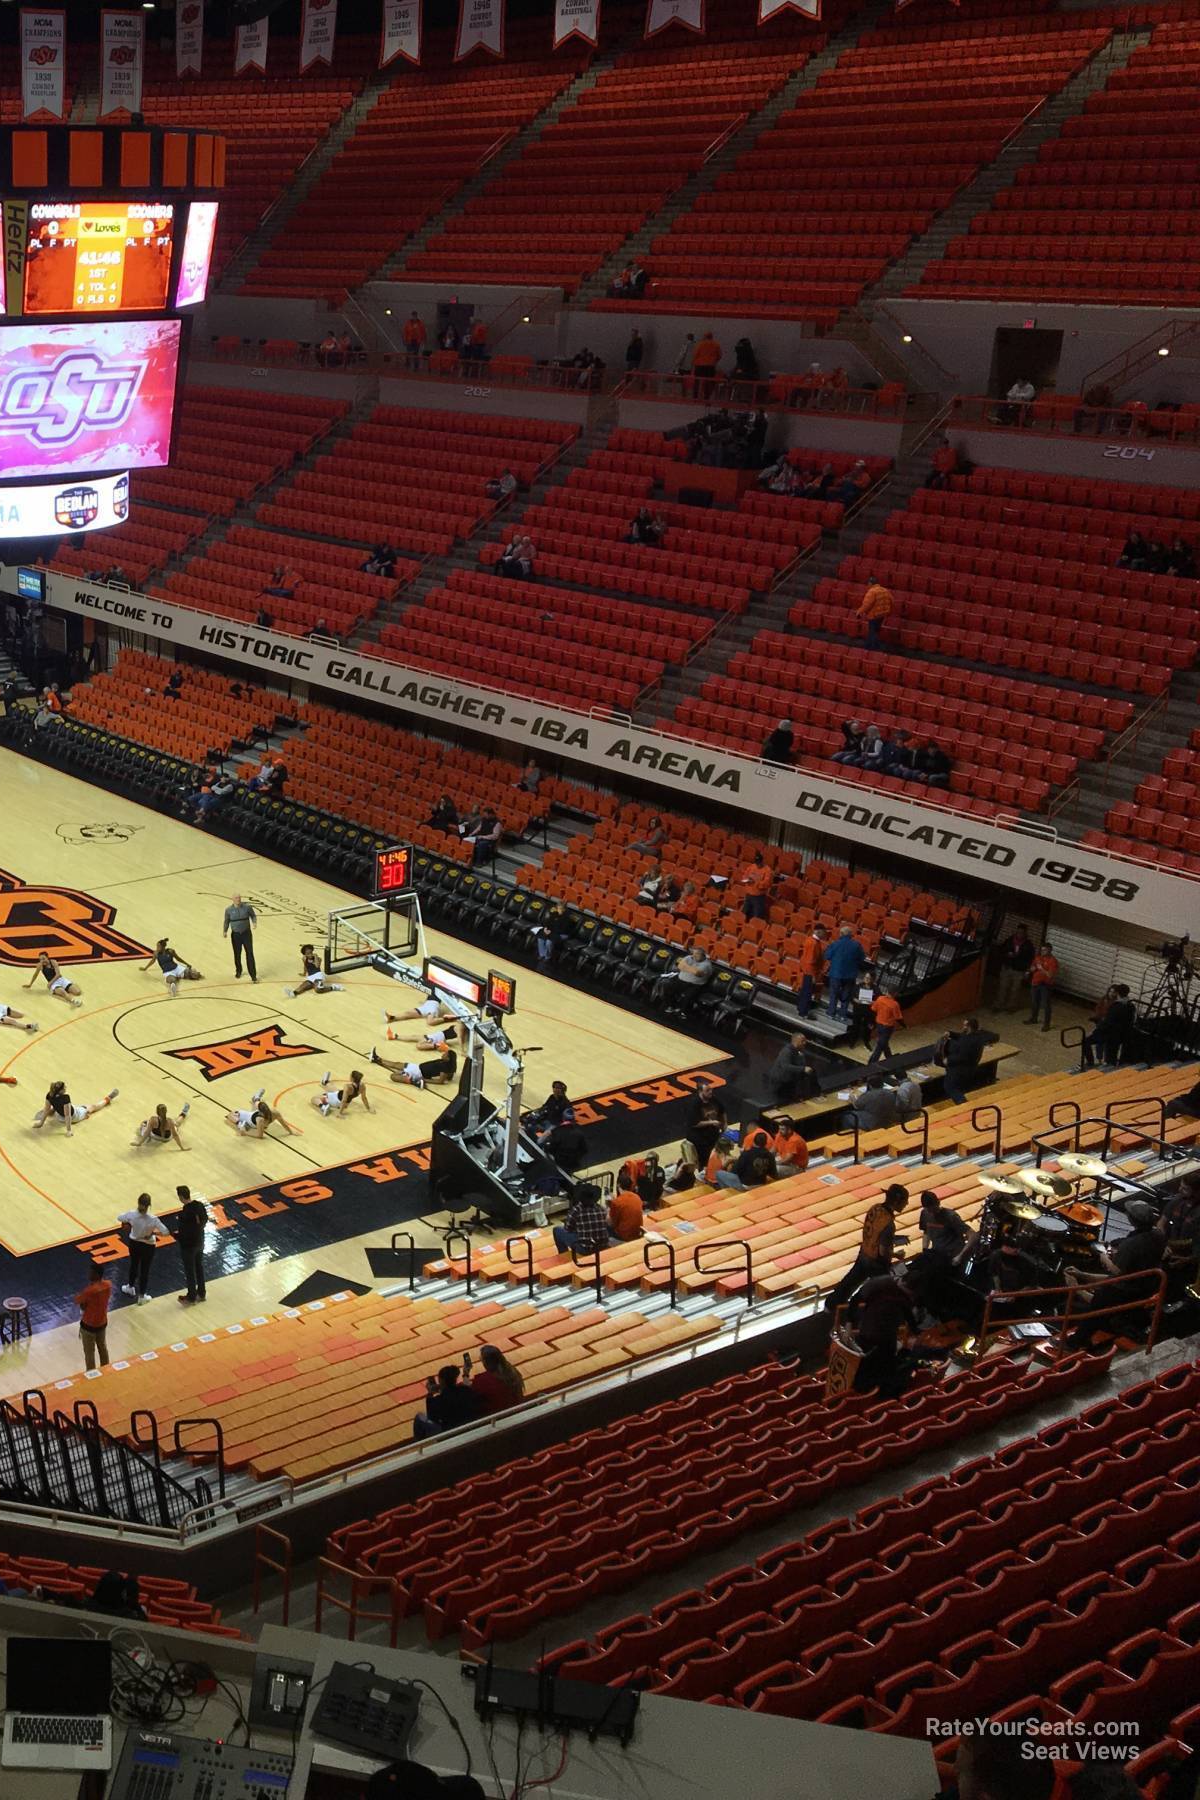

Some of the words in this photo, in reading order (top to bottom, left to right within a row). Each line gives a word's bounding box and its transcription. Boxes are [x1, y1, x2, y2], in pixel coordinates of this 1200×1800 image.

[560, 7, 593, 16] BASKETBALL
[25, 29, 62, 38] CHAMPIONS
[48, 221, 59, 235] 0
[143, 220, 154, 235] 0
[7, 205, 25, 275] Hertz
[30, 239, 42, 248] PL
[49, 239, 57, 248] F
[63, 239, 77, 248] PT
[125, 238, 137, 247] PL
[143, 238, 151, 247] F
[156, 237, 170, 247] PT
[1103, 444, 1155, 462] 204
[73, 590, 146, 624] WELCOME
[150, 612, 174, 630] TO
[199, 622, 314, 672] HISTORIC
[606, 738, 742, 795] ARENA
[795, 790, 1018, 868] DEDICATED
[1028, 857, 1141, 902] 1938
[379, 850, 408, 865] 41:46
[381, 863, 405, 888] 30
